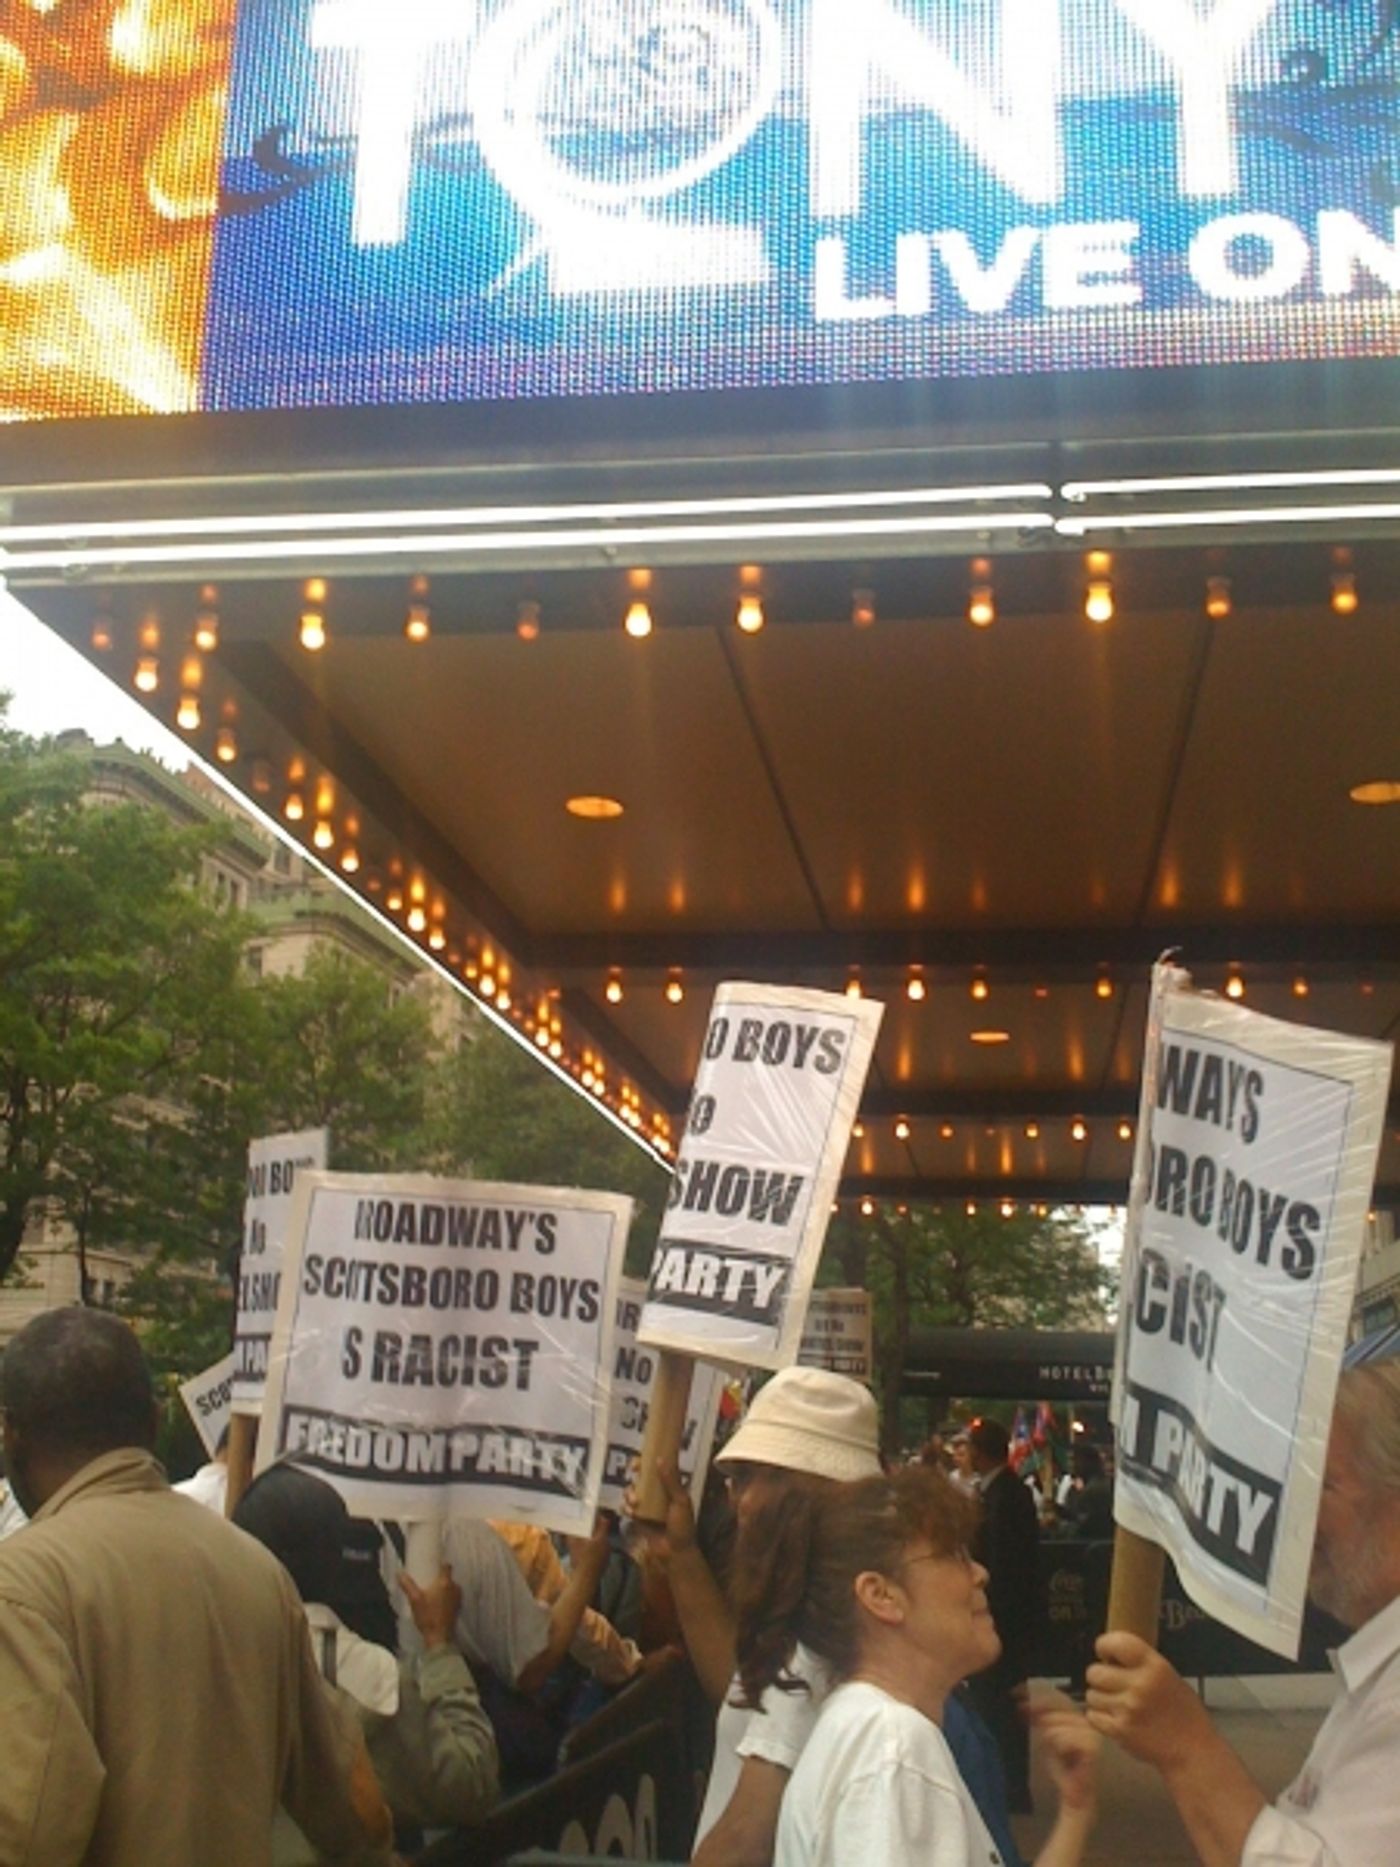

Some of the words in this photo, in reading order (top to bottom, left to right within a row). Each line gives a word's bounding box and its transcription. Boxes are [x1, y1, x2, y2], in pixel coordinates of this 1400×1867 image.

[308, 0, 1290, 262] TONY
[815, 225, 1142, 321] LIVE
[1187, 212, 1400, 303] ON
[732, 1018, 847, 1075] BOYS
[1145, 1143, 1217, 1228] RO
[1216, 1166, 1322, 1280] BOYS
[509, 1271, 600, 1324] BOYS
[370, 1328, 540, 1392] RACIST
[1039, 1365, 1093, 1381] HOTEL
[448, 1431, 587, 1493] PARTY
